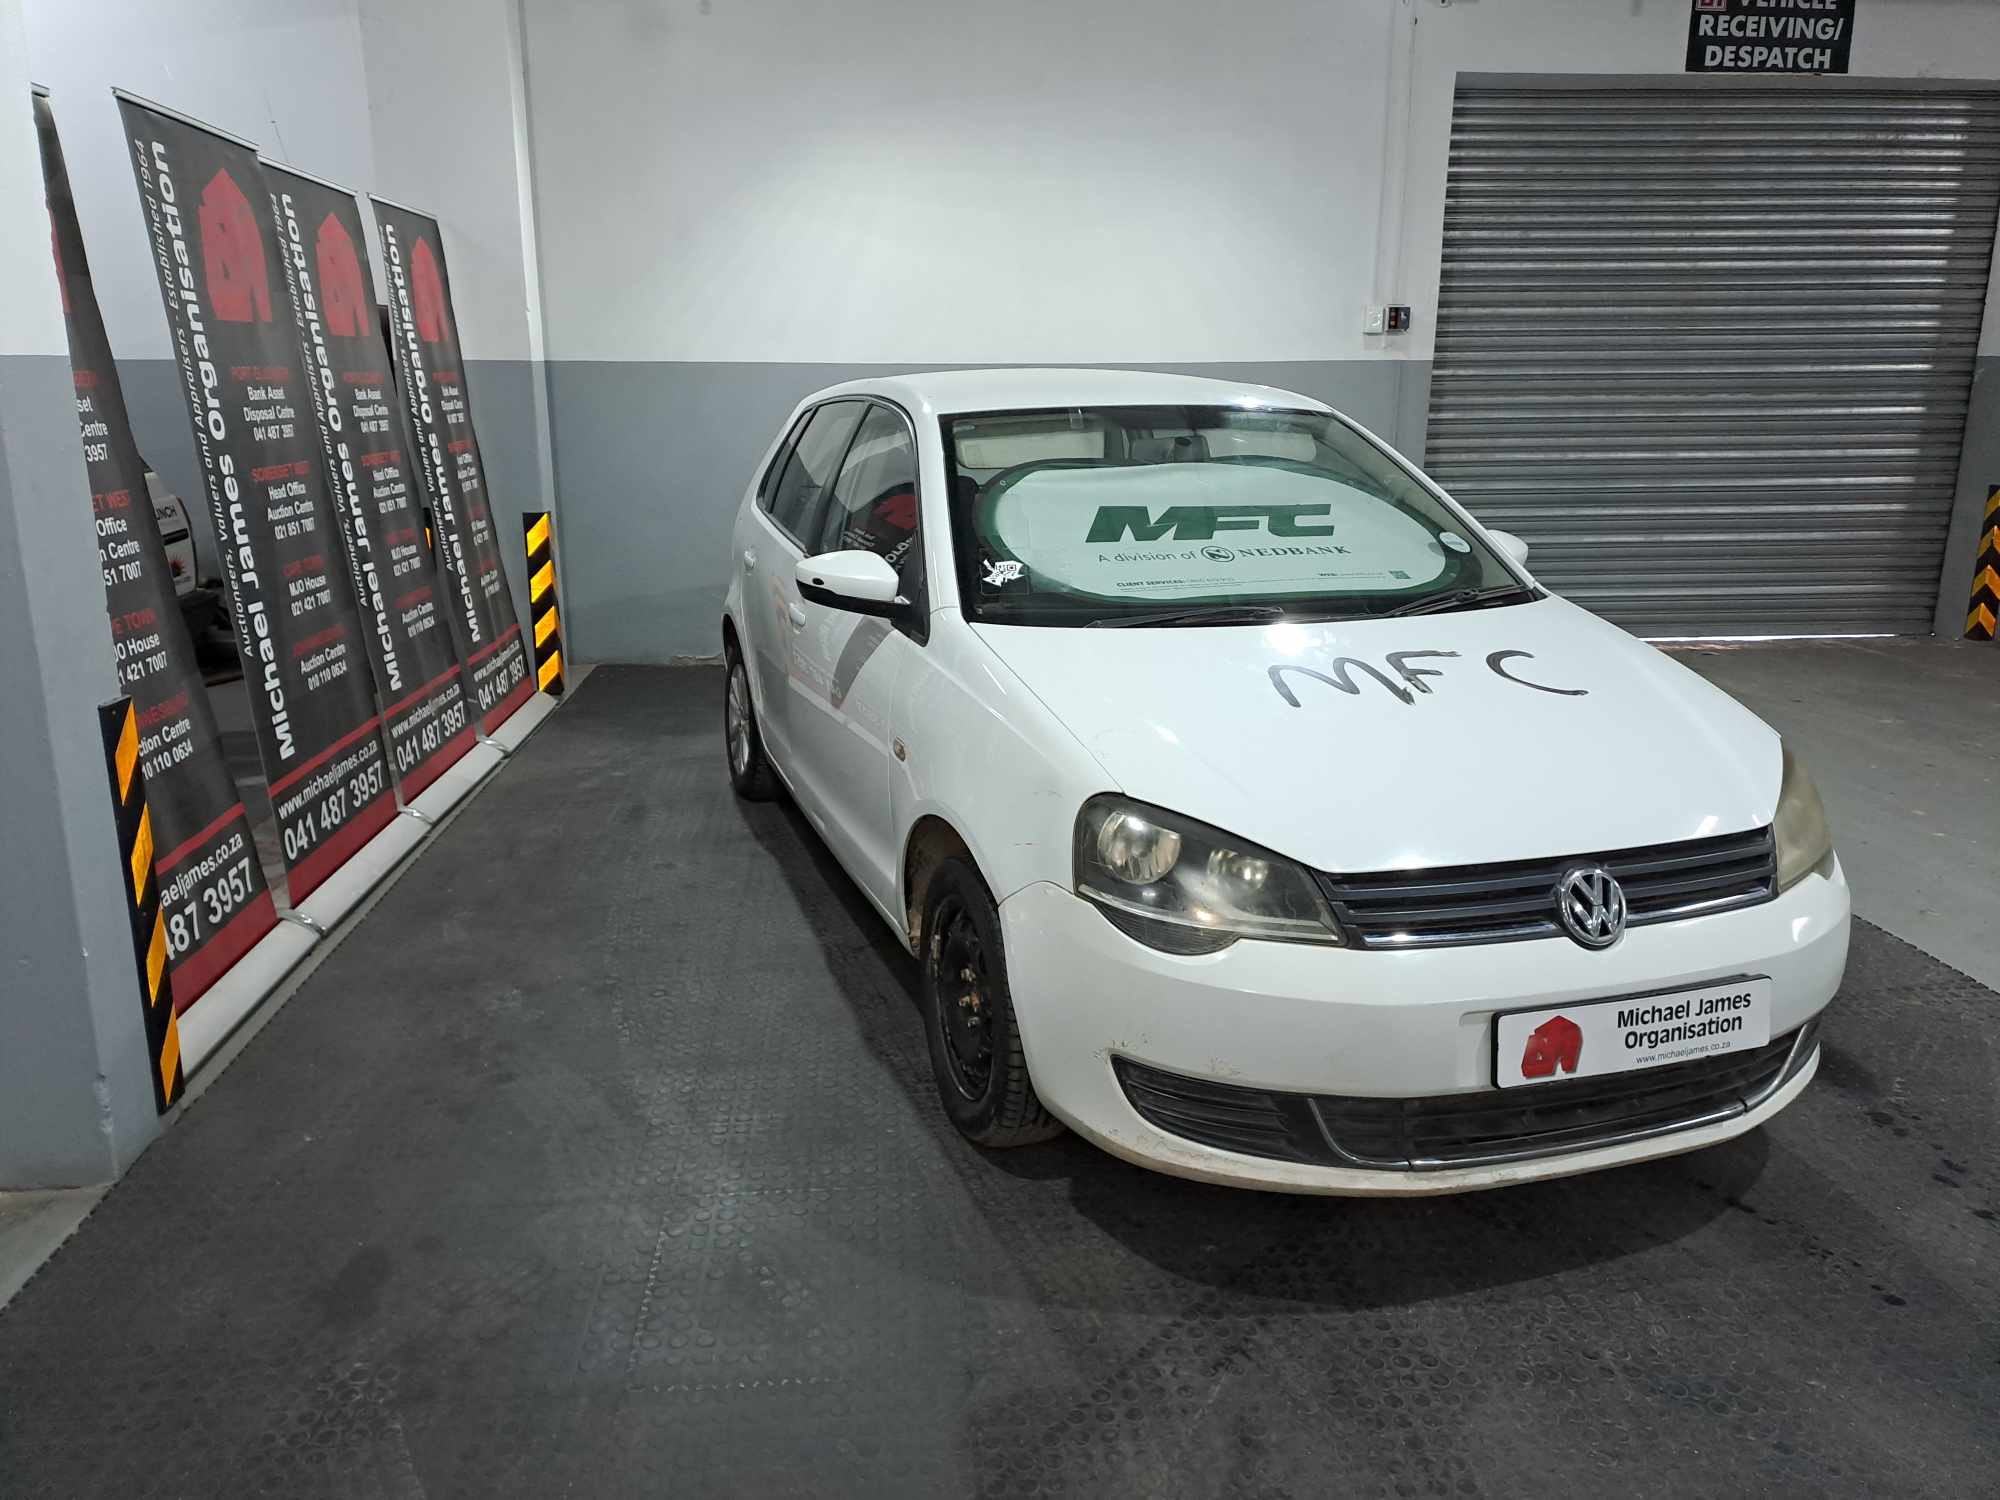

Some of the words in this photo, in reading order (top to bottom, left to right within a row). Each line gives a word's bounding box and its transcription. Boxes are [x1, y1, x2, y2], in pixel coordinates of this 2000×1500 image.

[1698, 14, 1844, 41] RECEIVING/
[1703, 45, 1832, 70] DESPATCH
[134, 138, 154, 190] 1964
[145, 194, 179, 310] Established
[152, 140, 227, 441] Organisation
[281, 193, 343, 432] Organisation
[385, 223, 433, 424] Organisation
[176, 328, 206, 429] Appraisers
[247, 386, 267, 401] Bank
[302, 341, 326, 423] Appraisers
[243, 406, 276, 423] Disposal
[84, 443, 108, 462] 3957
[197, 432, 214, 468] and
[319, 423, 334, 455] and
[267, 487, 287, 501] Head
[328, 458, 346, 513] Valuers
[337, 442, 372, 553] James
[428, 432, 456, 526] James
[96, 516, 128, 537] Office
[208, 474, 228, 541] Valuers
[218, 454, 260, 590] James
[1085, 503, 1335, 543] MFC
[108, 539, 141, 560] Centre
[118, 560, 143, 583] 7007
[1097, 553, 1112, 563] A
[1113, 550, 1177, 564] division
[1180, 549, 1199, 561] of
[1238, 544, 1353, 557] NEDBANK
[225, 549, 254, 657] Auctioneers,
[448, 533, 481, 643] Michael
[127, 632, 161, 656] House
[362, 561, 403, 692] Michael
[126, 660, 147, 682] 421
[146, 650, 169, 675] 7007
[247, 601, 297, 761] Michael
[300, 656, 326, 676] Auction
[478, 684, 498, 710] 041
[495, 669, 509, 697] 487
[161, 716, 192, 743] Centre
[396, 736, 421, 772] 041
[422, 719, 441, 753] 487
[441, 700, 466, 738] 3957
[278, 739, 378, 821] www.michaeljames.co.za
[284, 812, 317, 861] 041
[320, 786, 347, 831] 487
[349, 760, 384, 808] 3957
[160, 832, 244, 908] aeljames.co.za
[202, 856, 253, 924] 3957
[1617, 999, 1690, 1029] Michael
[1694, 992, 1752, 1017] James
[1624, 1014, 1743, 1050] Organisation
[1635, 1039, 1732, 1065] www.michaeljames.co.za
